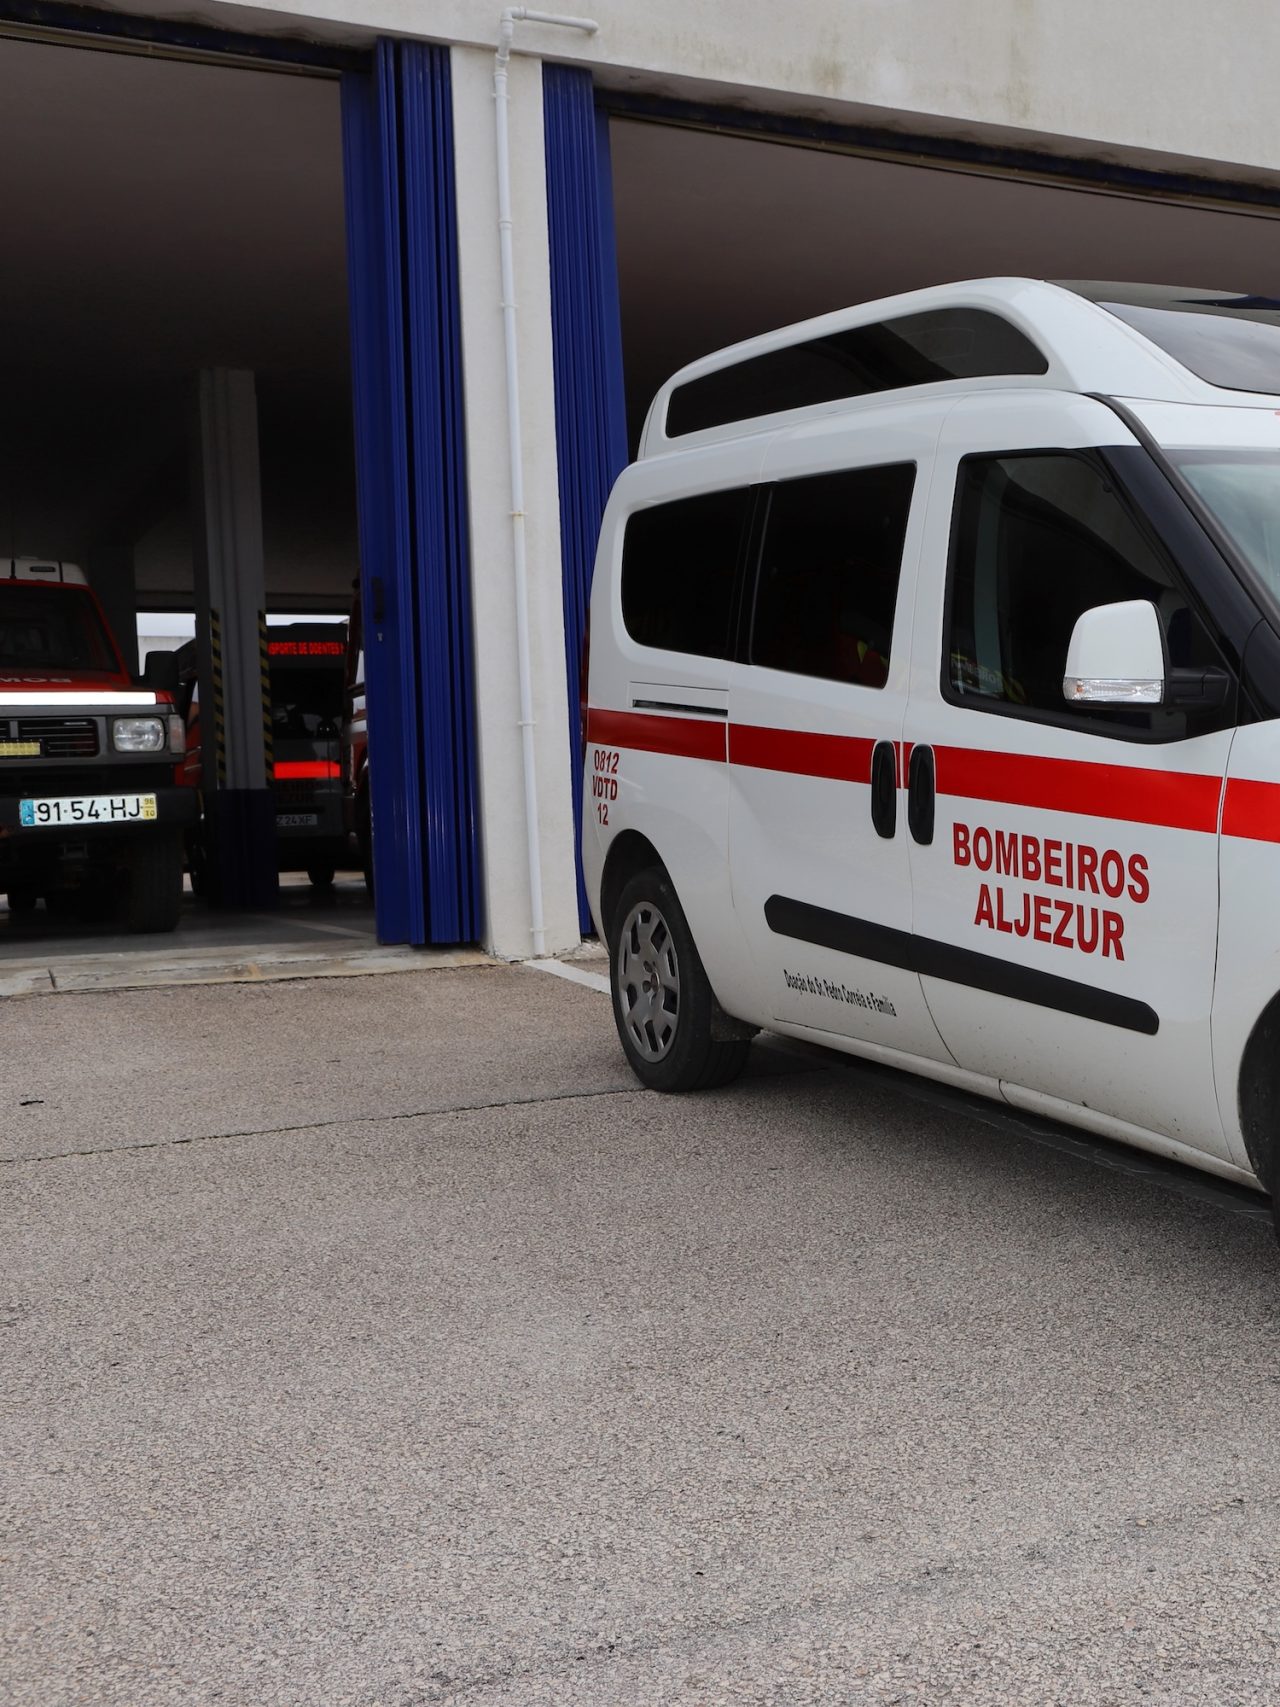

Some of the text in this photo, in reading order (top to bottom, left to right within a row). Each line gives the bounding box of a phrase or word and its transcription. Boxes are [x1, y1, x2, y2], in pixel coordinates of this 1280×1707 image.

[594, 749, 620, 774] 0812
[597, 802, 609, 826] 12
[953, 822, 1150, 904] BOMBEIROS
[974, 883, 1125, 961] ALJEZUR
